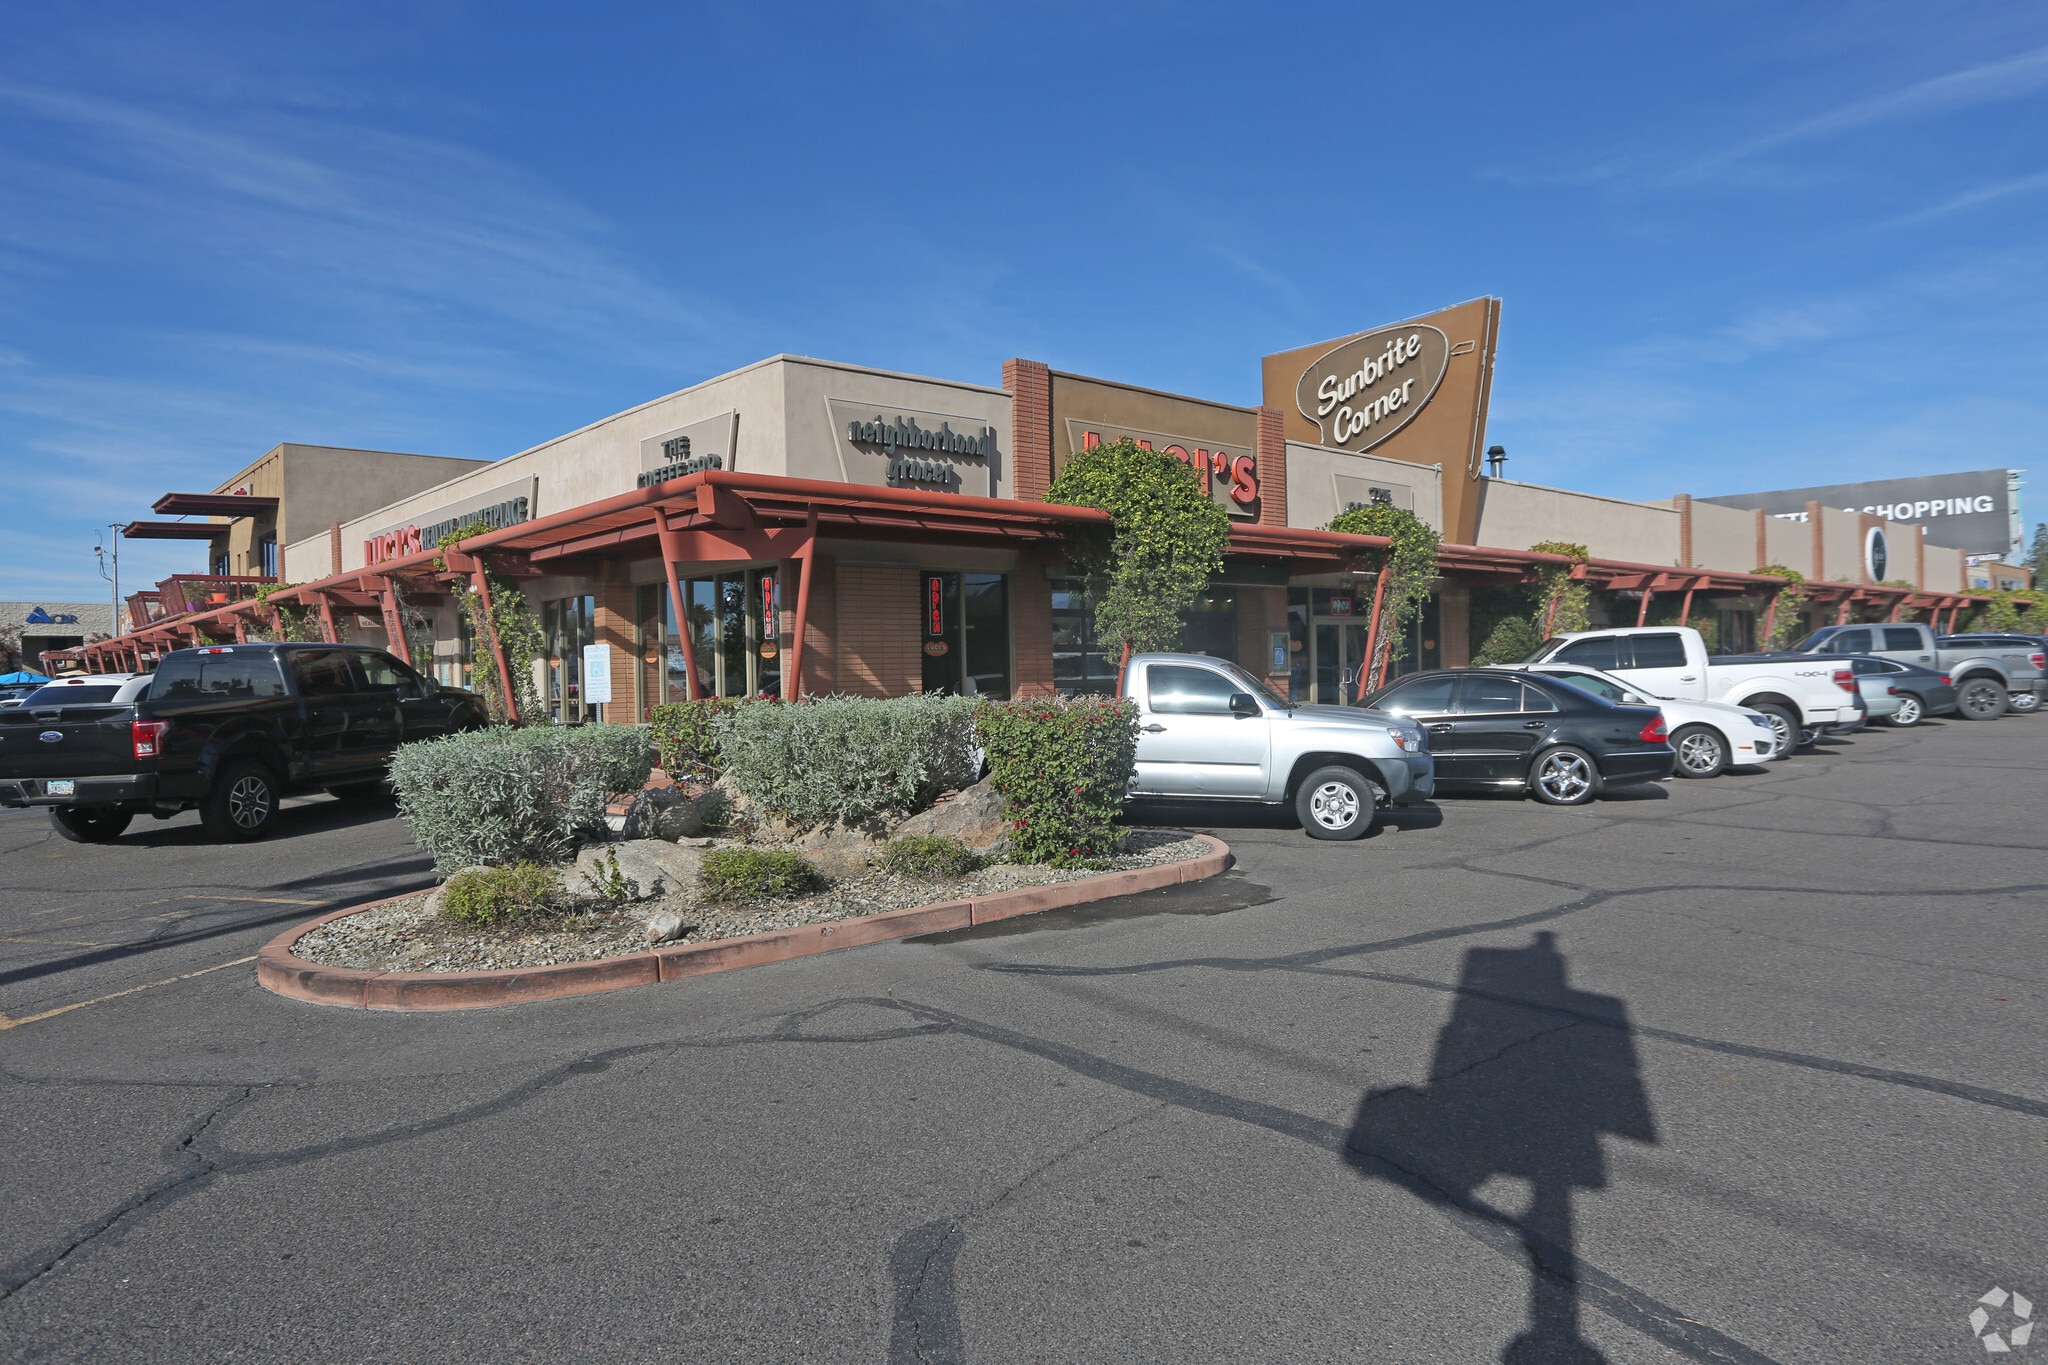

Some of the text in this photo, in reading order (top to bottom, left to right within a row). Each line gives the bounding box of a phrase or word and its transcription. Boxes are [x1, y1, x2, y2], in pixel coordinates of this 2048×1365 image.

[1317, 334, 1422, 416] Sunbrite
[1333, 378, 1415, 444] Corner
[661, 436, 690, 459] THE
[848, 414, 988, 457] neighborhood
[885, 458, 954, 487] grocer
